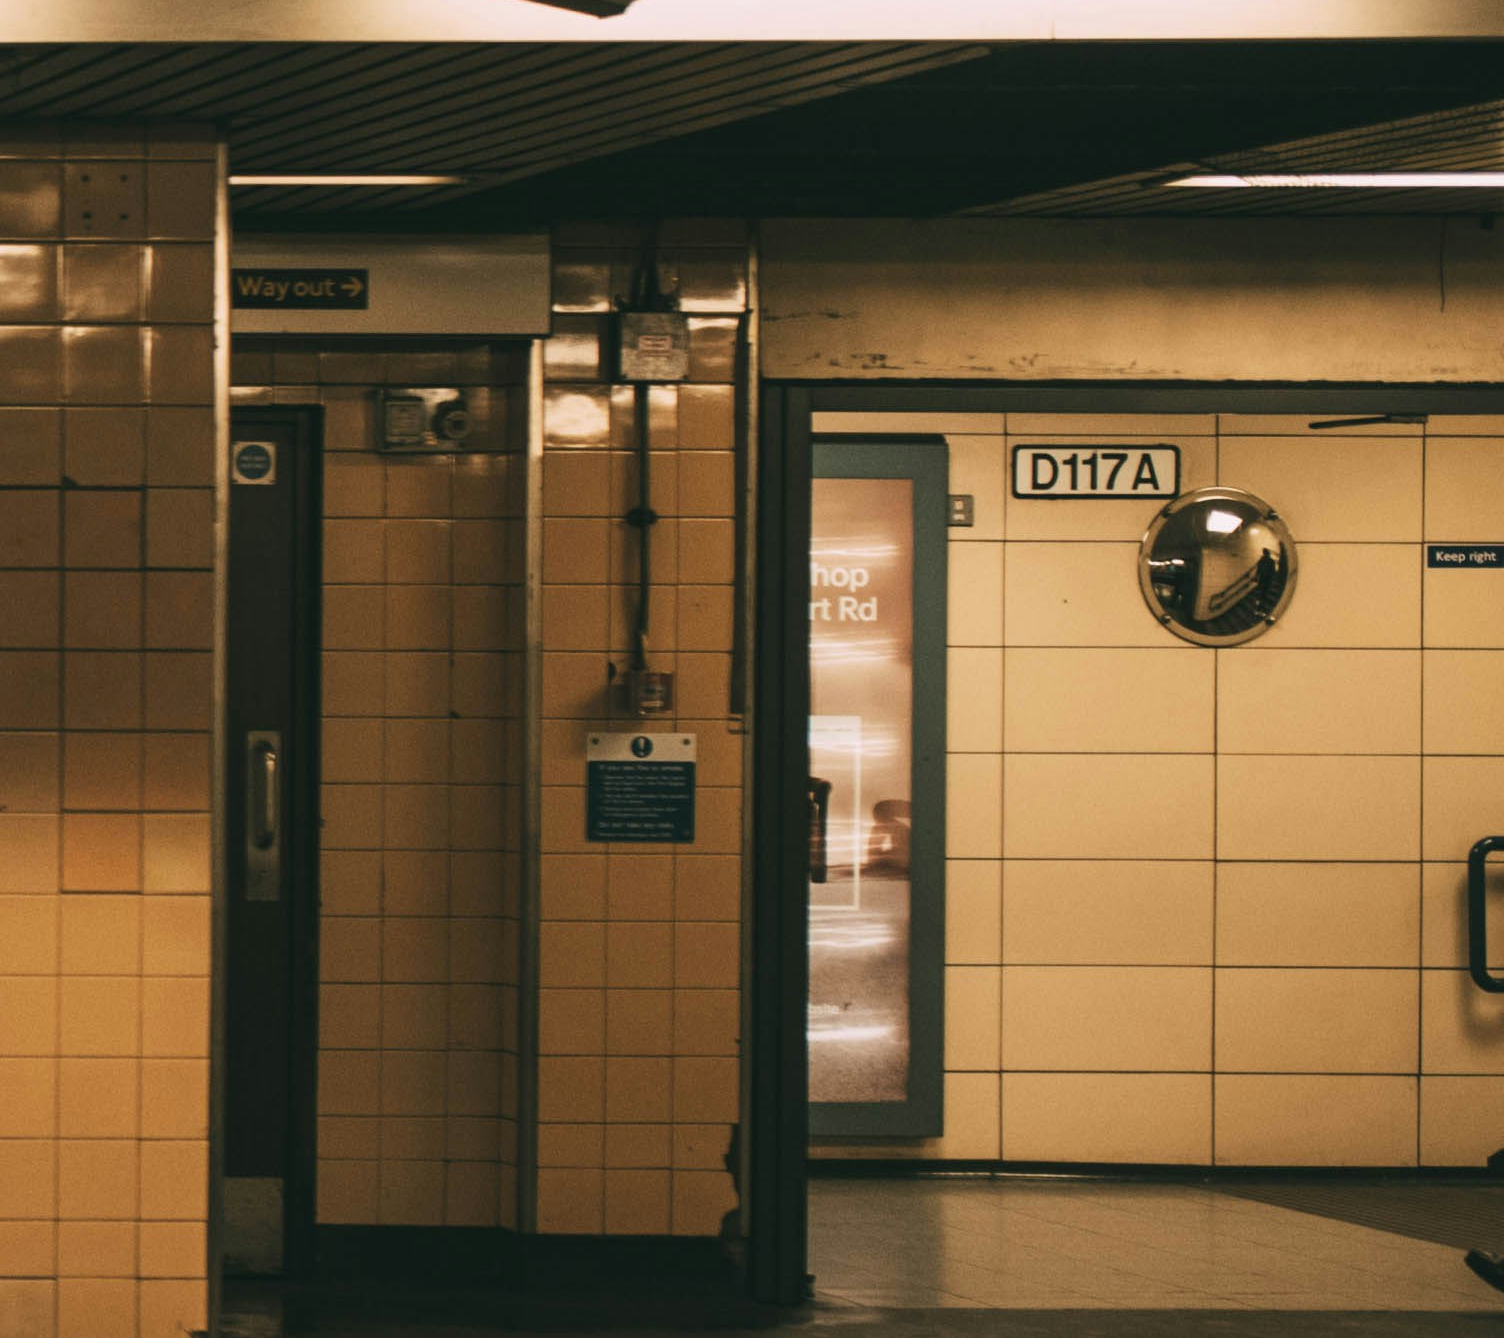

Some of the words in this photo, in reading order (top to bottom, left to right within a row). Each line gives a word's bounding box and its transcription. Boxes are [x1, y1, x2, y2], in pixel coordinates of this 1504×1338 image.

[238, 276, 289, 302] Way
[293, 278, 337, 297] out
[1030, 452, 1161, 493] D117A
[1435, 551, 1466, 564] Keep
[1469, 551, 1497, 564] right
[838, 596, 878, 622] Rd
